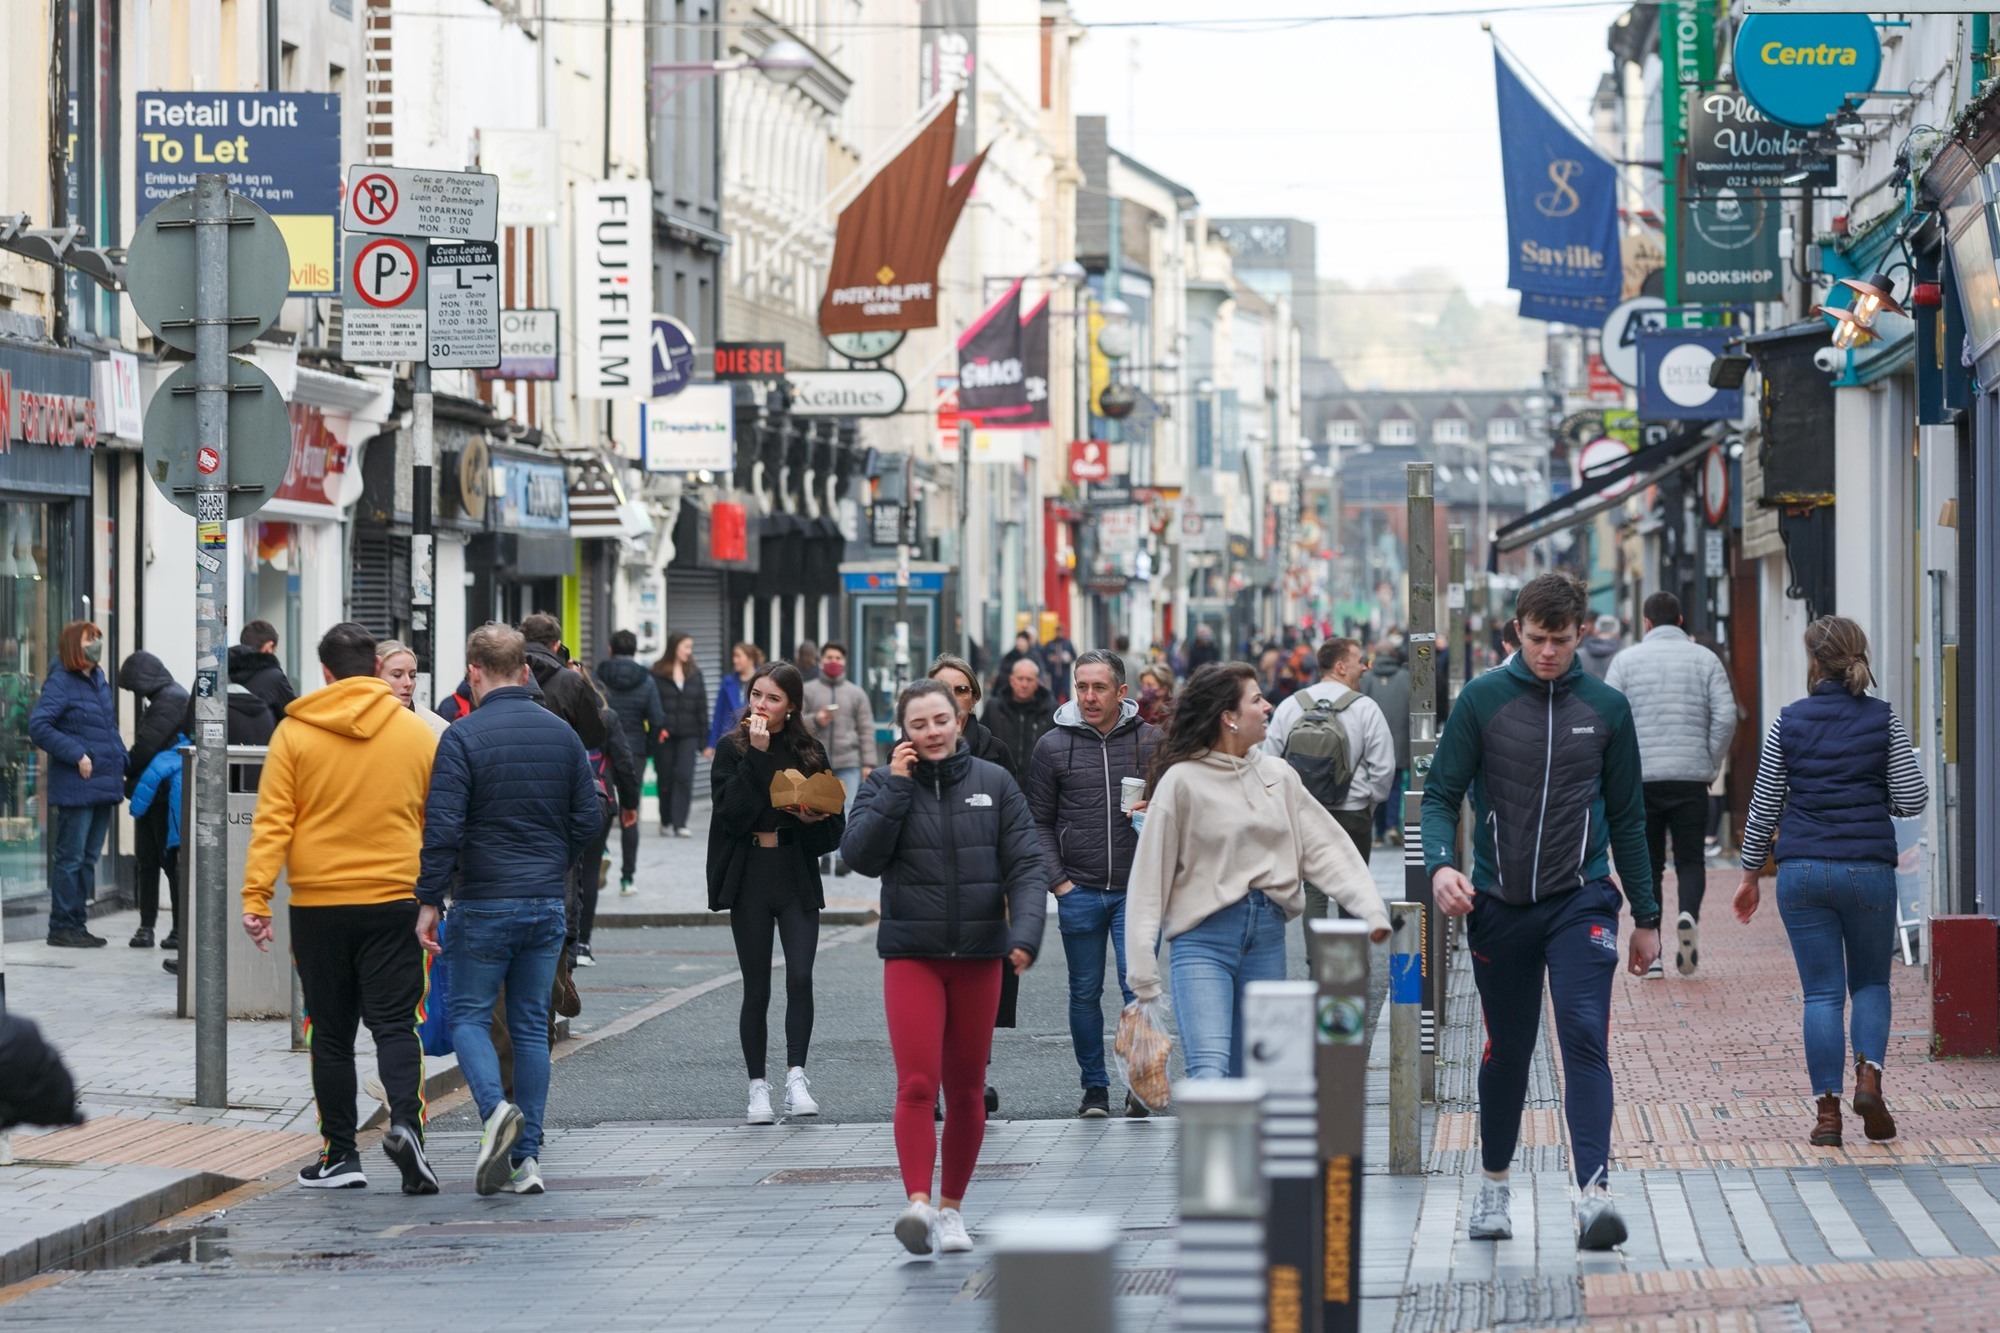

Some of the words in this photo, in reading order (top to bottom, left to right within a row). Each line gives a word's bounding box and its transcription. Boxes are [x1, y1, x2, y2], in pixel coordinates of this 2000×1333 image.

[1761, 41, 1857, 65] Centra
[145, 99, 228, 126] Retail
[238, 99, 298, 127] Unit
[143, 133, 183, 163] To
[194, 133, 249, 163] Let
[1696, 162, 1732, 171] Diamond
[1734, 162, 1751, 171] And
[145, 172, 175, 185] Entire
[245, 175, 259, 186] sq
[261, 175, 273, 185] m
[1727, 176, 1747, 187] 021
[250, 187, 263, 199] 74
[266, 189, 280, 201] sq
[282, 189, 294, 199] m
[423, 185, 444, 194] 11:00
[419, 205, 432, 214] NO
[434, 207, 473, 217] PARKING
[420, 215, 441, 224] 11:00
[449, 217, 471, 226] 17:00
[431, 255, 472, 265] LOADING
[474, 253, 492, 263] BAY
[1521, 239, 1604, 269] Saville
[291, 263, 330, 286] vills
[1685, 269, 1773, 285] BOOKSHOP
[597, 196, 629, 387] FUJIFILM
[876, 282, 932, 301] PHILIPPE
[438, 318, 459, 326] 17:00
[504, 315, 536, 333] Off
[432, 344, 450, 357] 30
[715, 349, 785, 373] DIESEL
[796, 380, 884, 407] Keanes
[20, 391, 40, 443] FOR
[44, 395, 76, 446] TOOLS
[199, 495, 223, 508] SHARK
